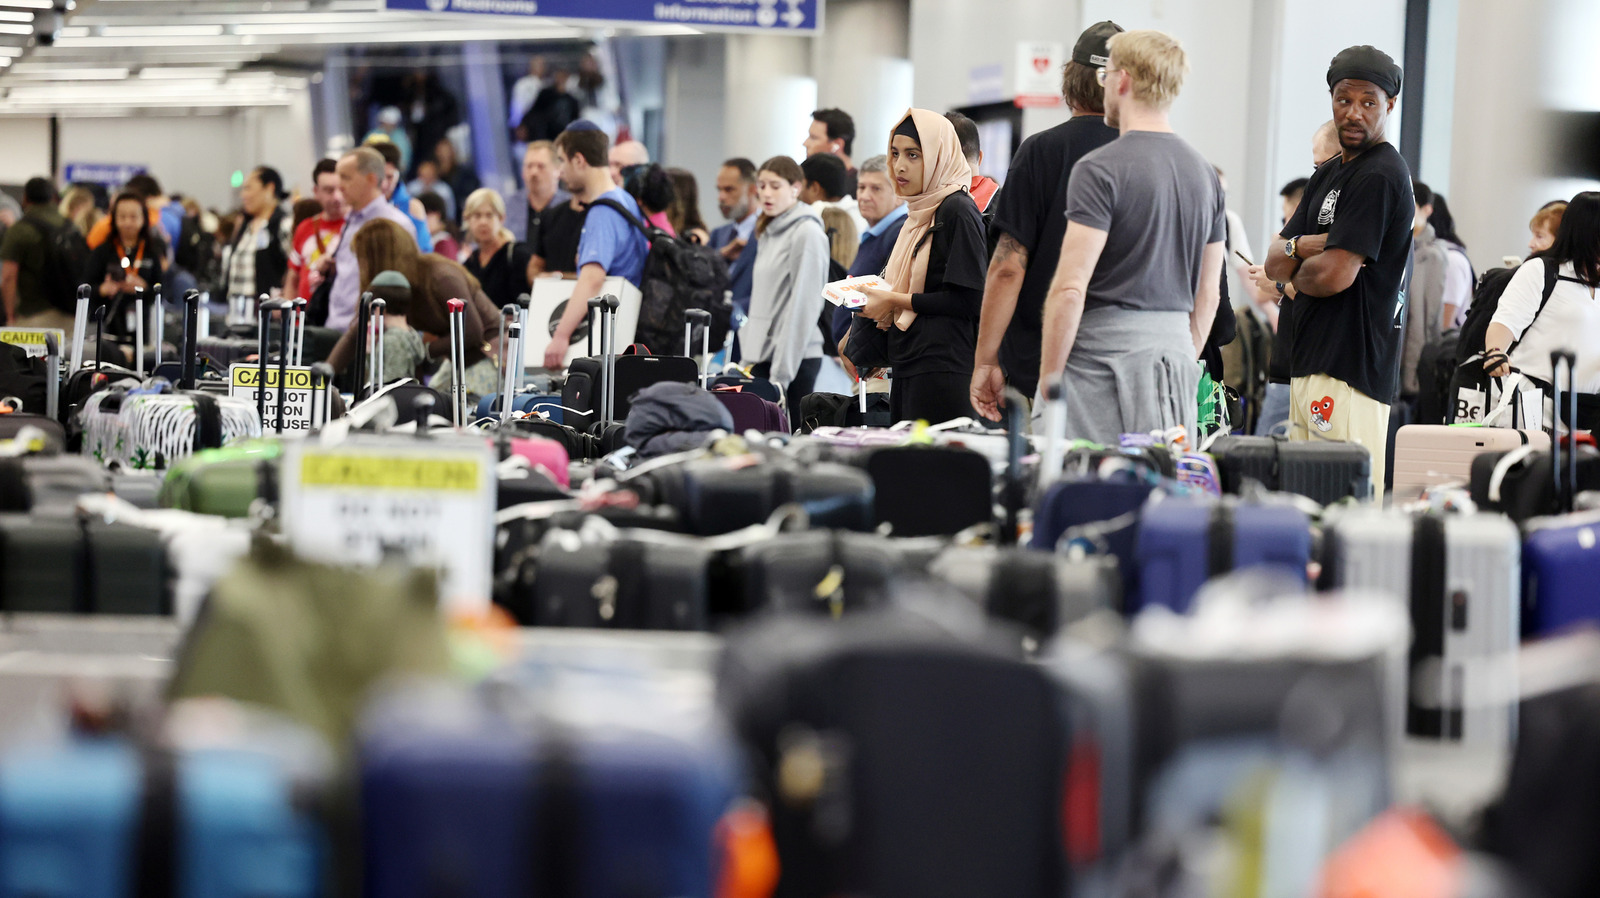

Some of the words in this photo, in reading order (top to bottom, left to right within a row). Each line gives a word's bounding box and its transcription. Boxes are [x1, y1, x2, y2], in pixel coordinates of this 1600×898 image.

[654, 3, 755, 23] Information
[3, 332, 46, 342] CAUTI
[253, 391, 273, 402] DO
